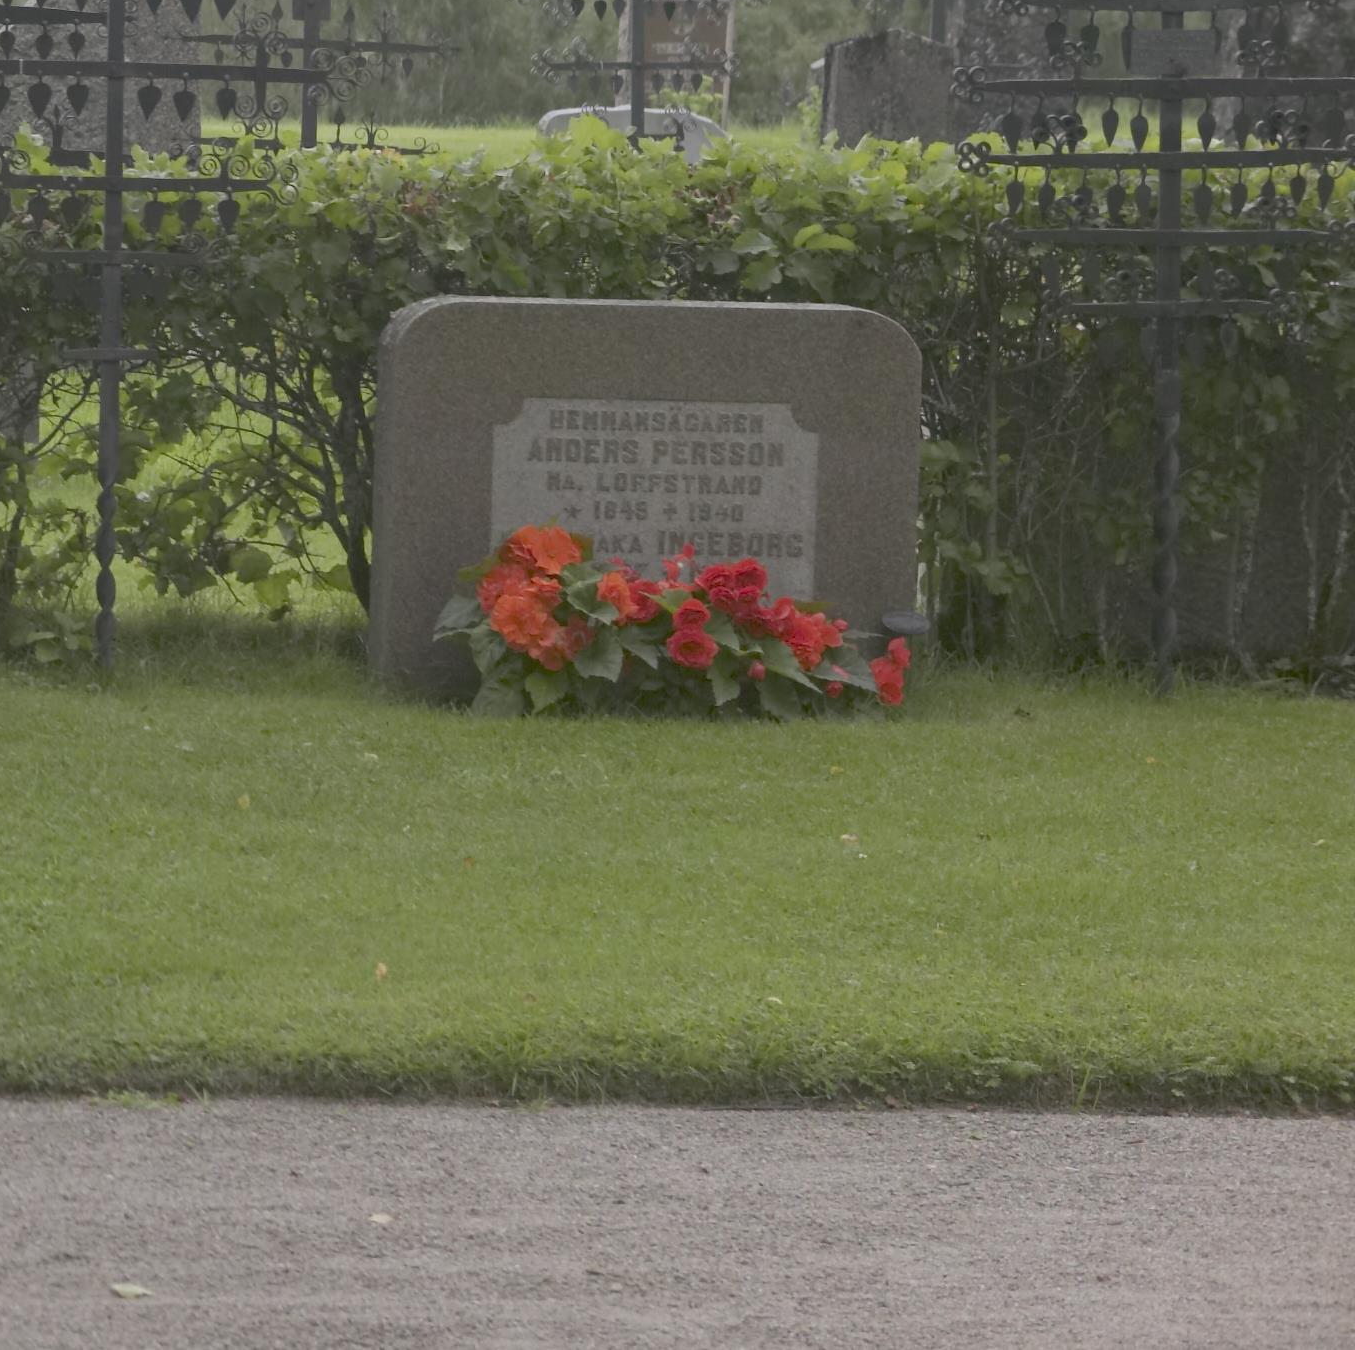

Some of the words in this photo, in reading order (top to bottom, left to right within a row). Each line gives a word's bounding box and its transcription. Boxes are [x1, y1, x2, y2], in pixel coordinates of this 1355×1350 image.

[549, 404, 764, 434] HEMMANSÄGAREN
[527, 437, 639, 465] ANDERS
[652, 439, 784, 467] PERSSON
[596, 471, 763, 496] LOFFSTRAND
[689, 501, 745, 523] 1940
[657, 530, 804, 558] INGEBORG
